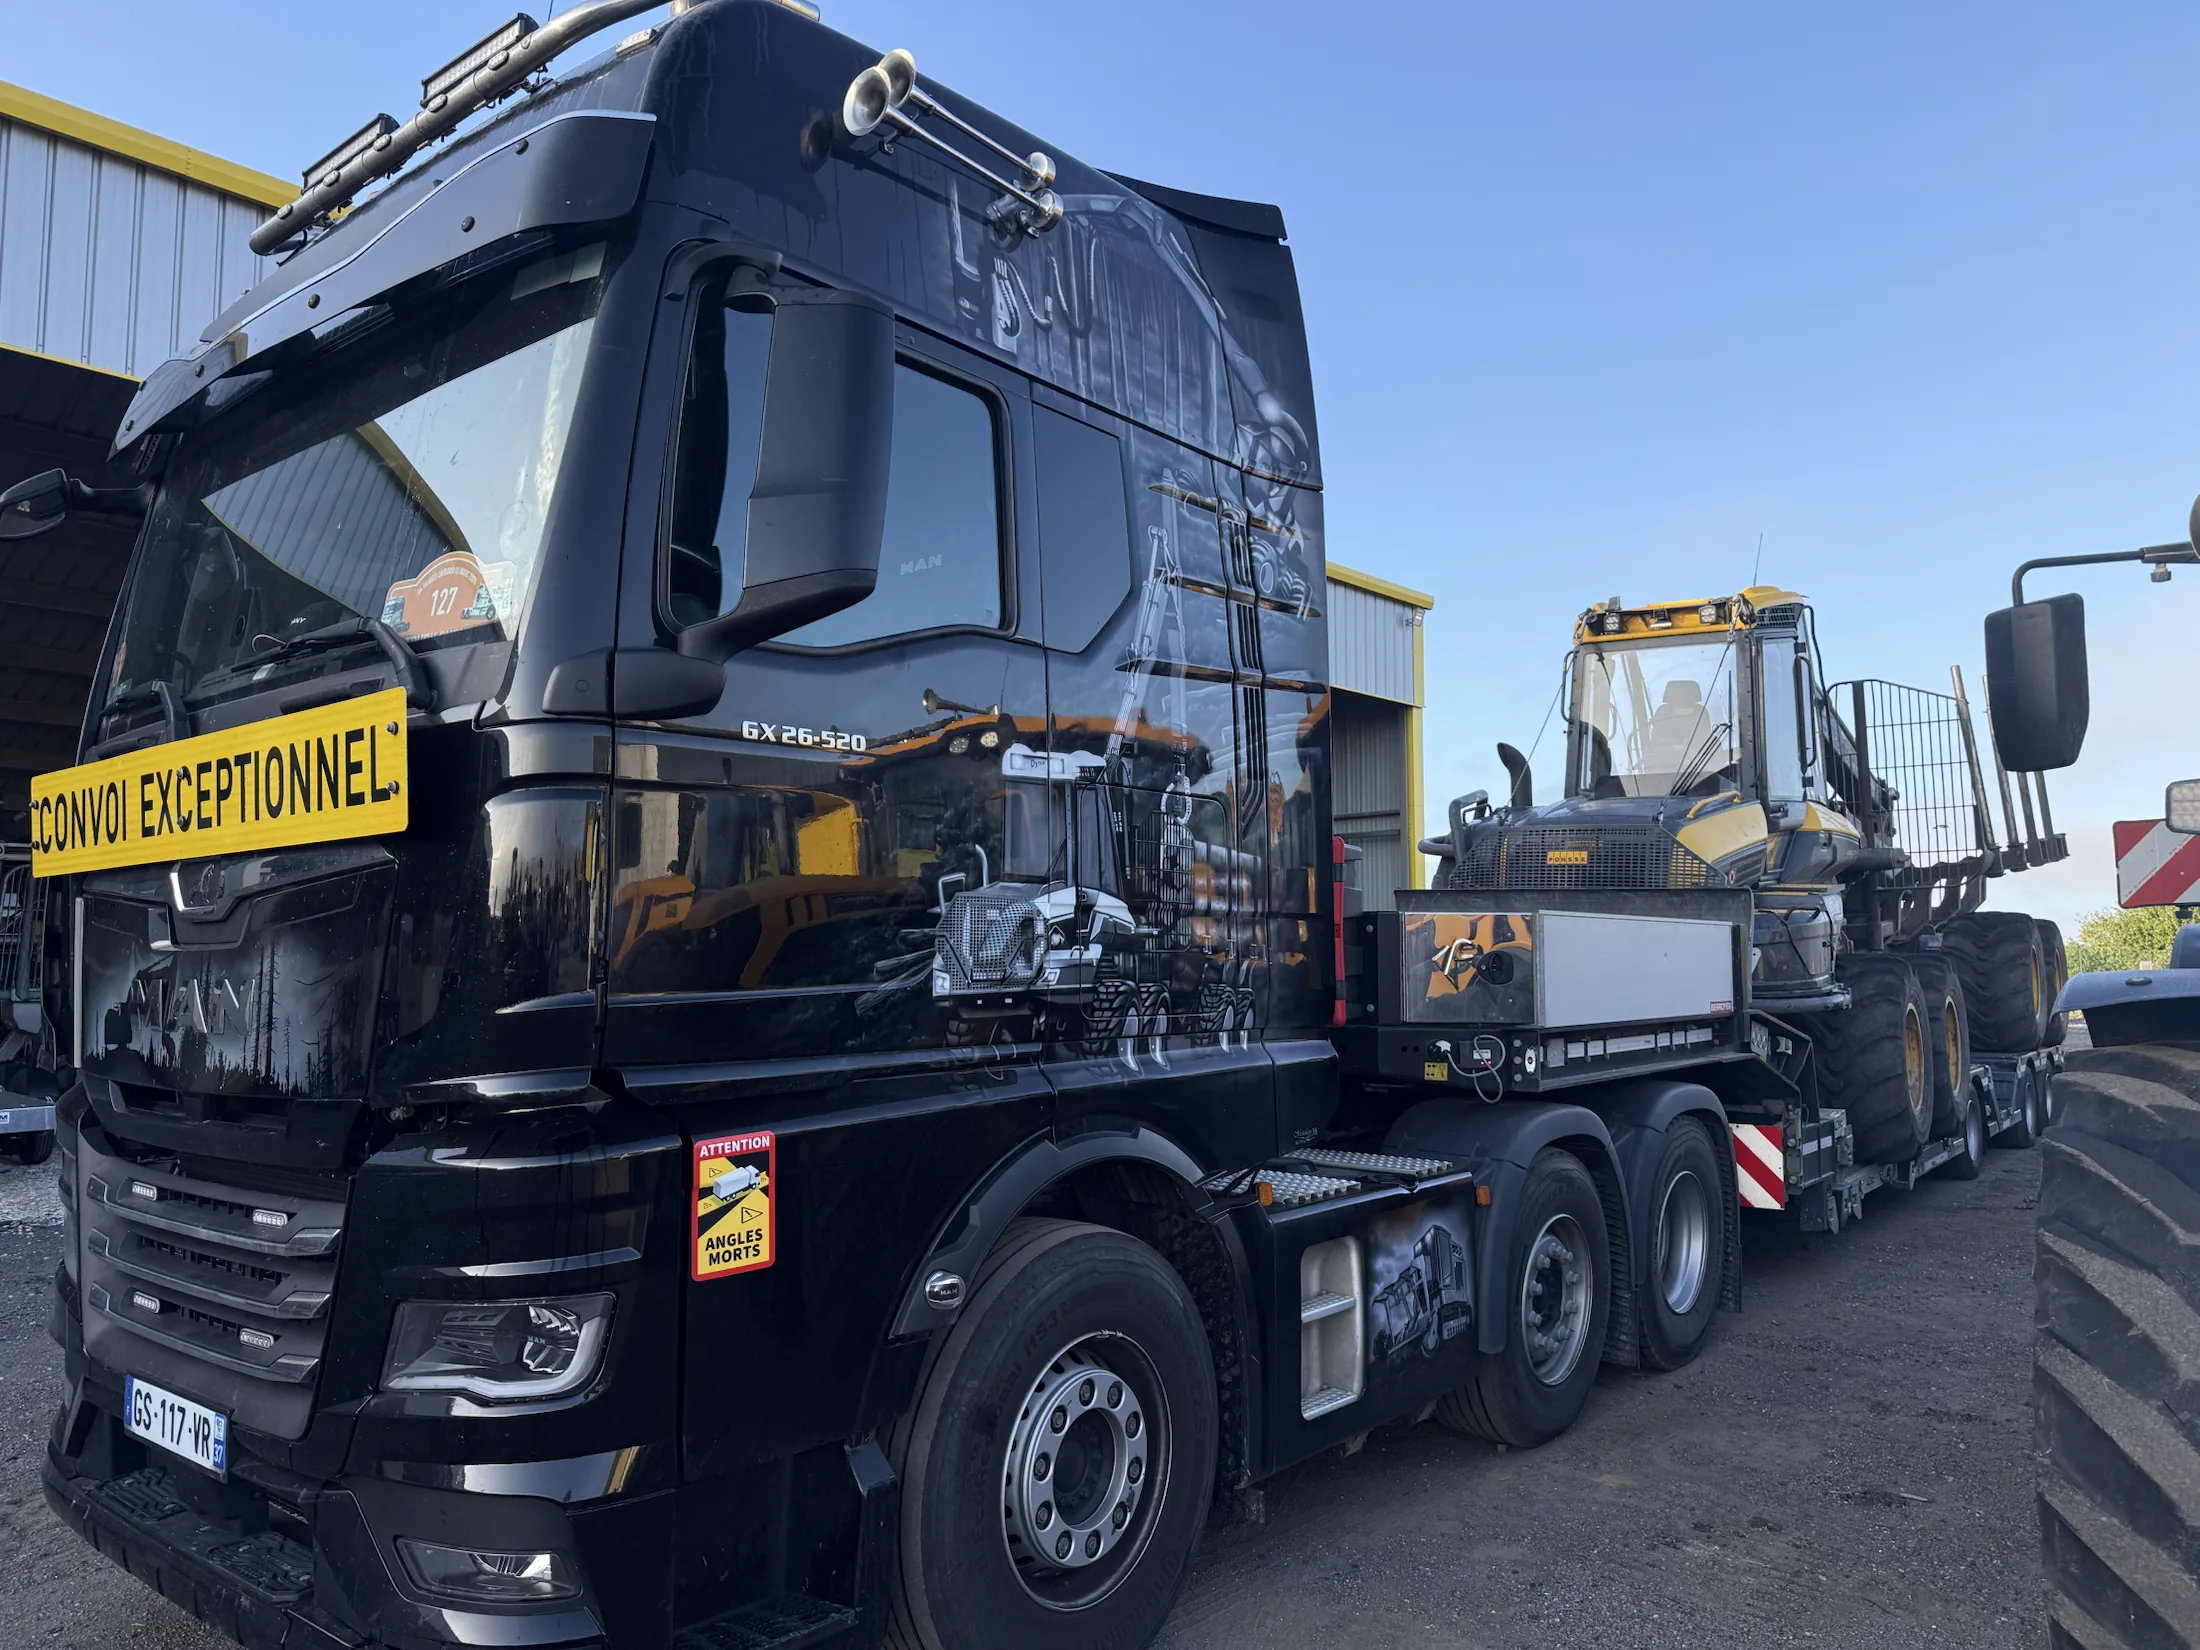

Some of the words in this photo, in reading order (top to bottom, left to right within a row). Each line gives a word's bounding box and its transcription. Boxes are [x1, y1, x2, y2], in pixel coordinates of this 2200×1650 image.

[900, 552, 942, 576] MAN
[430, 586, 459, 617] 127
[742, 720, 777, 742] GX
[39, 779, 127, 854] CONVOI
[141, 724, 391, 838] EXCEPTIONNEL
[130, 978, 255, 1036] MAN
[699, 1135, 770, 1158] ATTENTION
[705, 1228, 763, 1252] ANGLES
[709, 1243, 761, 1267] MORTS
[133, 1388, 211, 1461] GS-117-VR
[213, 1444, 224, 1464] 37
